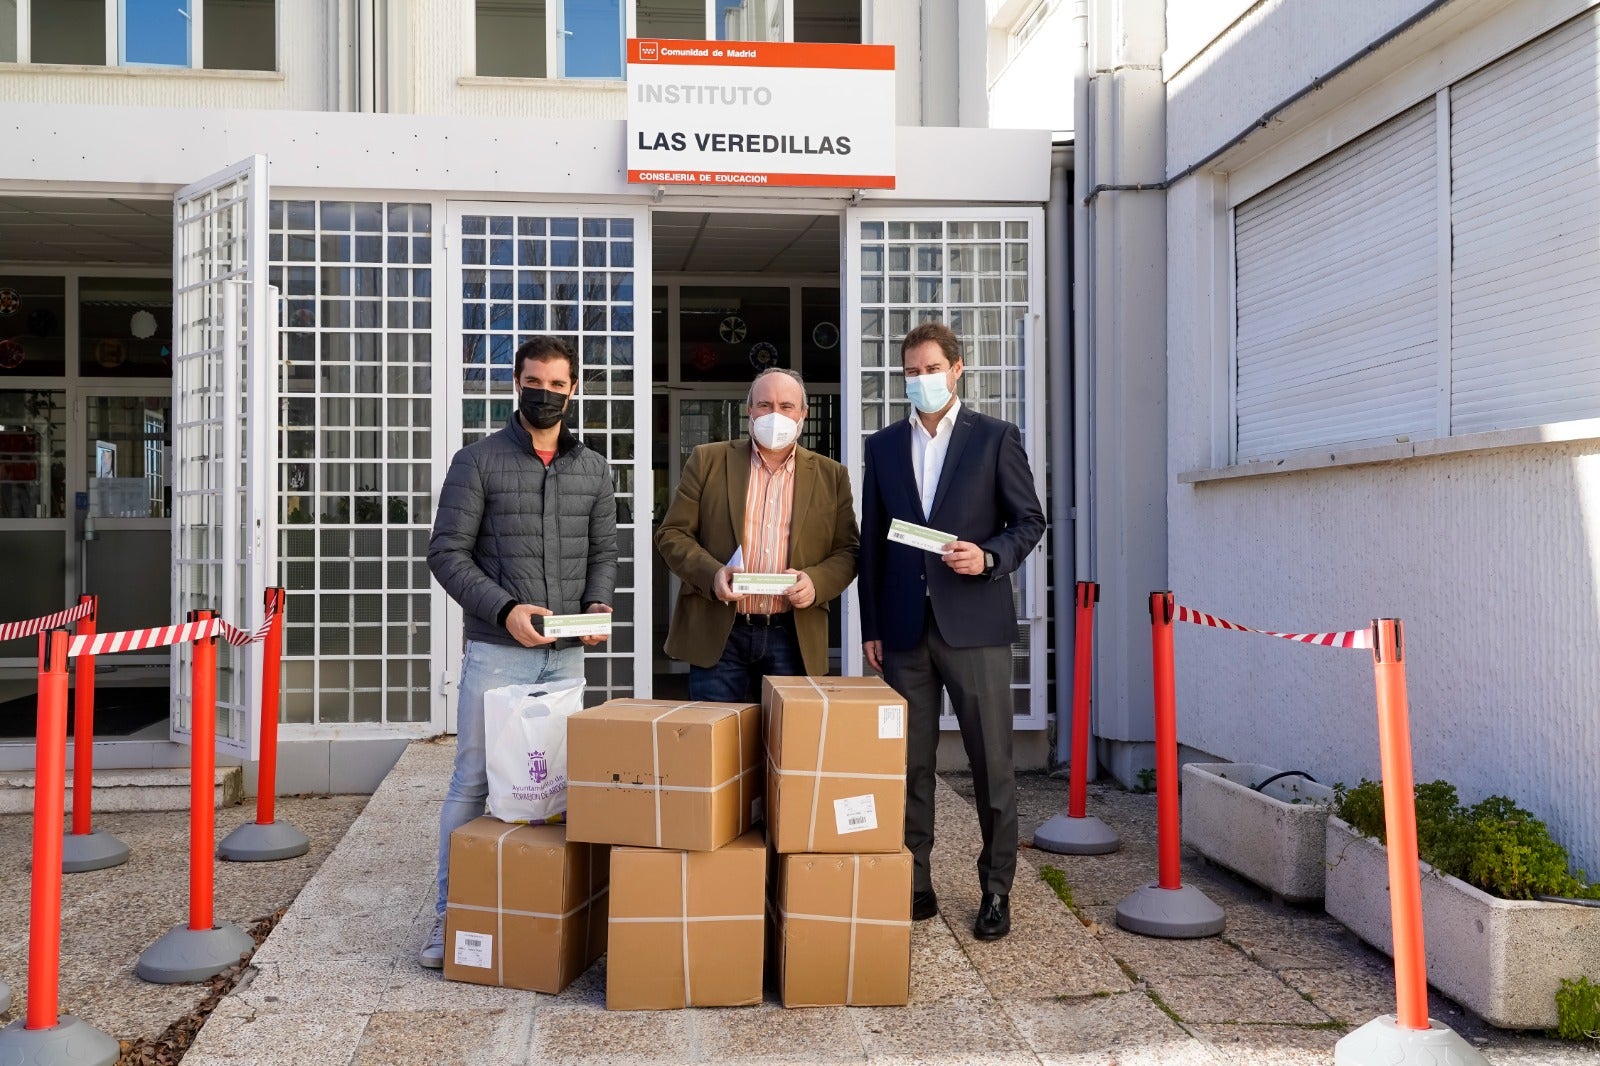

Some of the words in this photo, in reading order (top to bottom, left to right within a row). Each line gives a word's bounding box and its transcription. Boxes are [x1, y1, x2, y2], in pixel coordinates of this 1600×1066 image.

[660, 47, 708, 57] Comunidad
[712, 49, 723, 57] de
[726, 49, 756, 58] Madrid
[637, 84, 772, 106] INSTITUTO
[638, 131, 686, 151] LAS
[694, 133, 851, 155] VEREDILLAS
[639, 172, 695, 181] CONSEJERIA
[699, 174, 711, 182] DE
[715, 175, 767, 183] EDUCACION
[541, 791, 549, 800] DE
